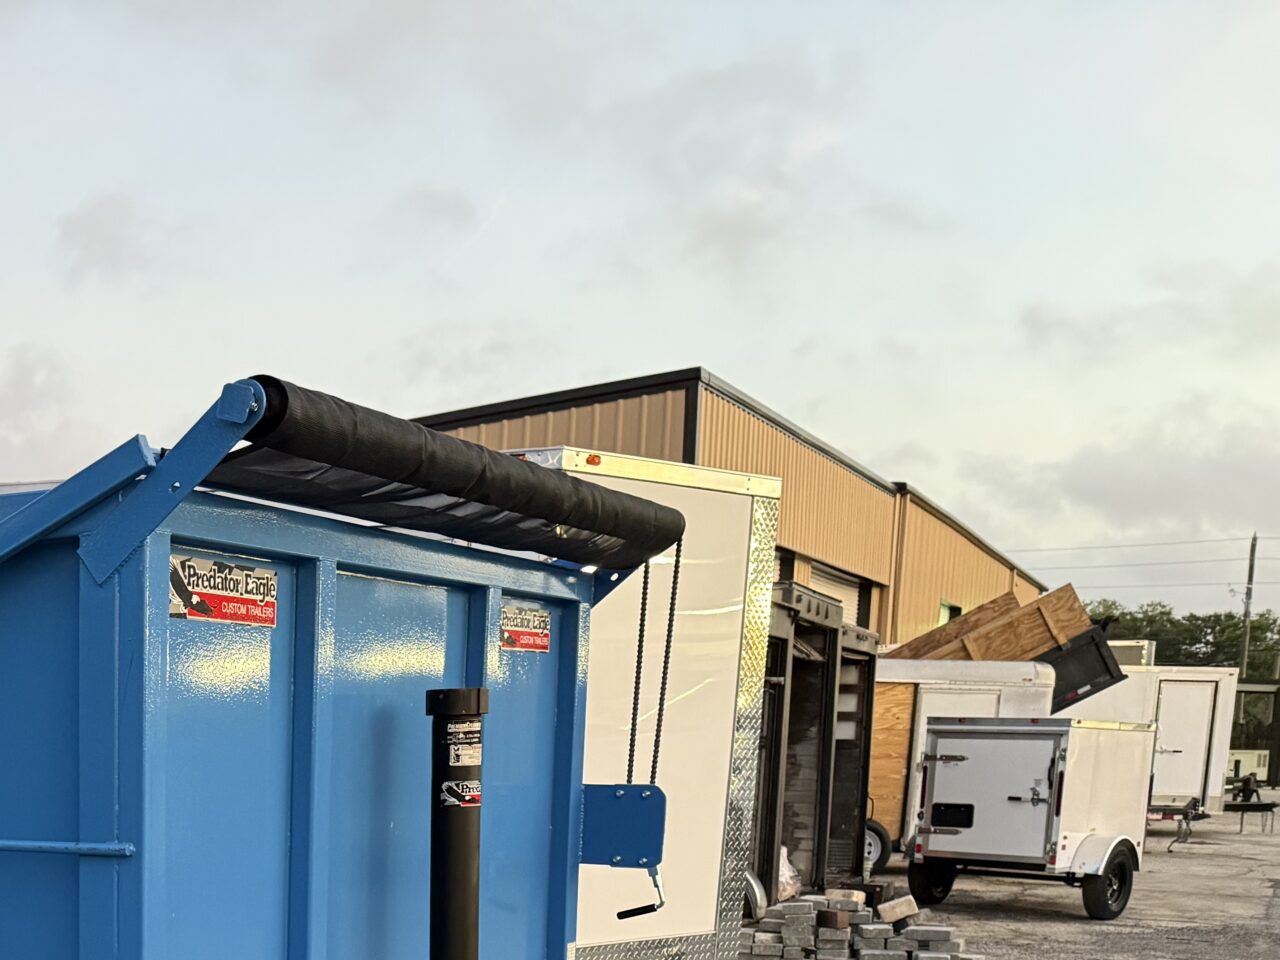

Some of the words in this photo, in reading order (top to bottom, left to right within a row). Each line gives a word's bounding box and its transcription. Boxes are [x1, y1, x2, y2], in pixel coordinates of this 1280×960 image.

[186, 562, 241, 593] Predator
[244, 572, 276, 603] Eagle
[221, 602, 246, 615] CUSTOM
[248, 605, 274, 618] TRAILERS
